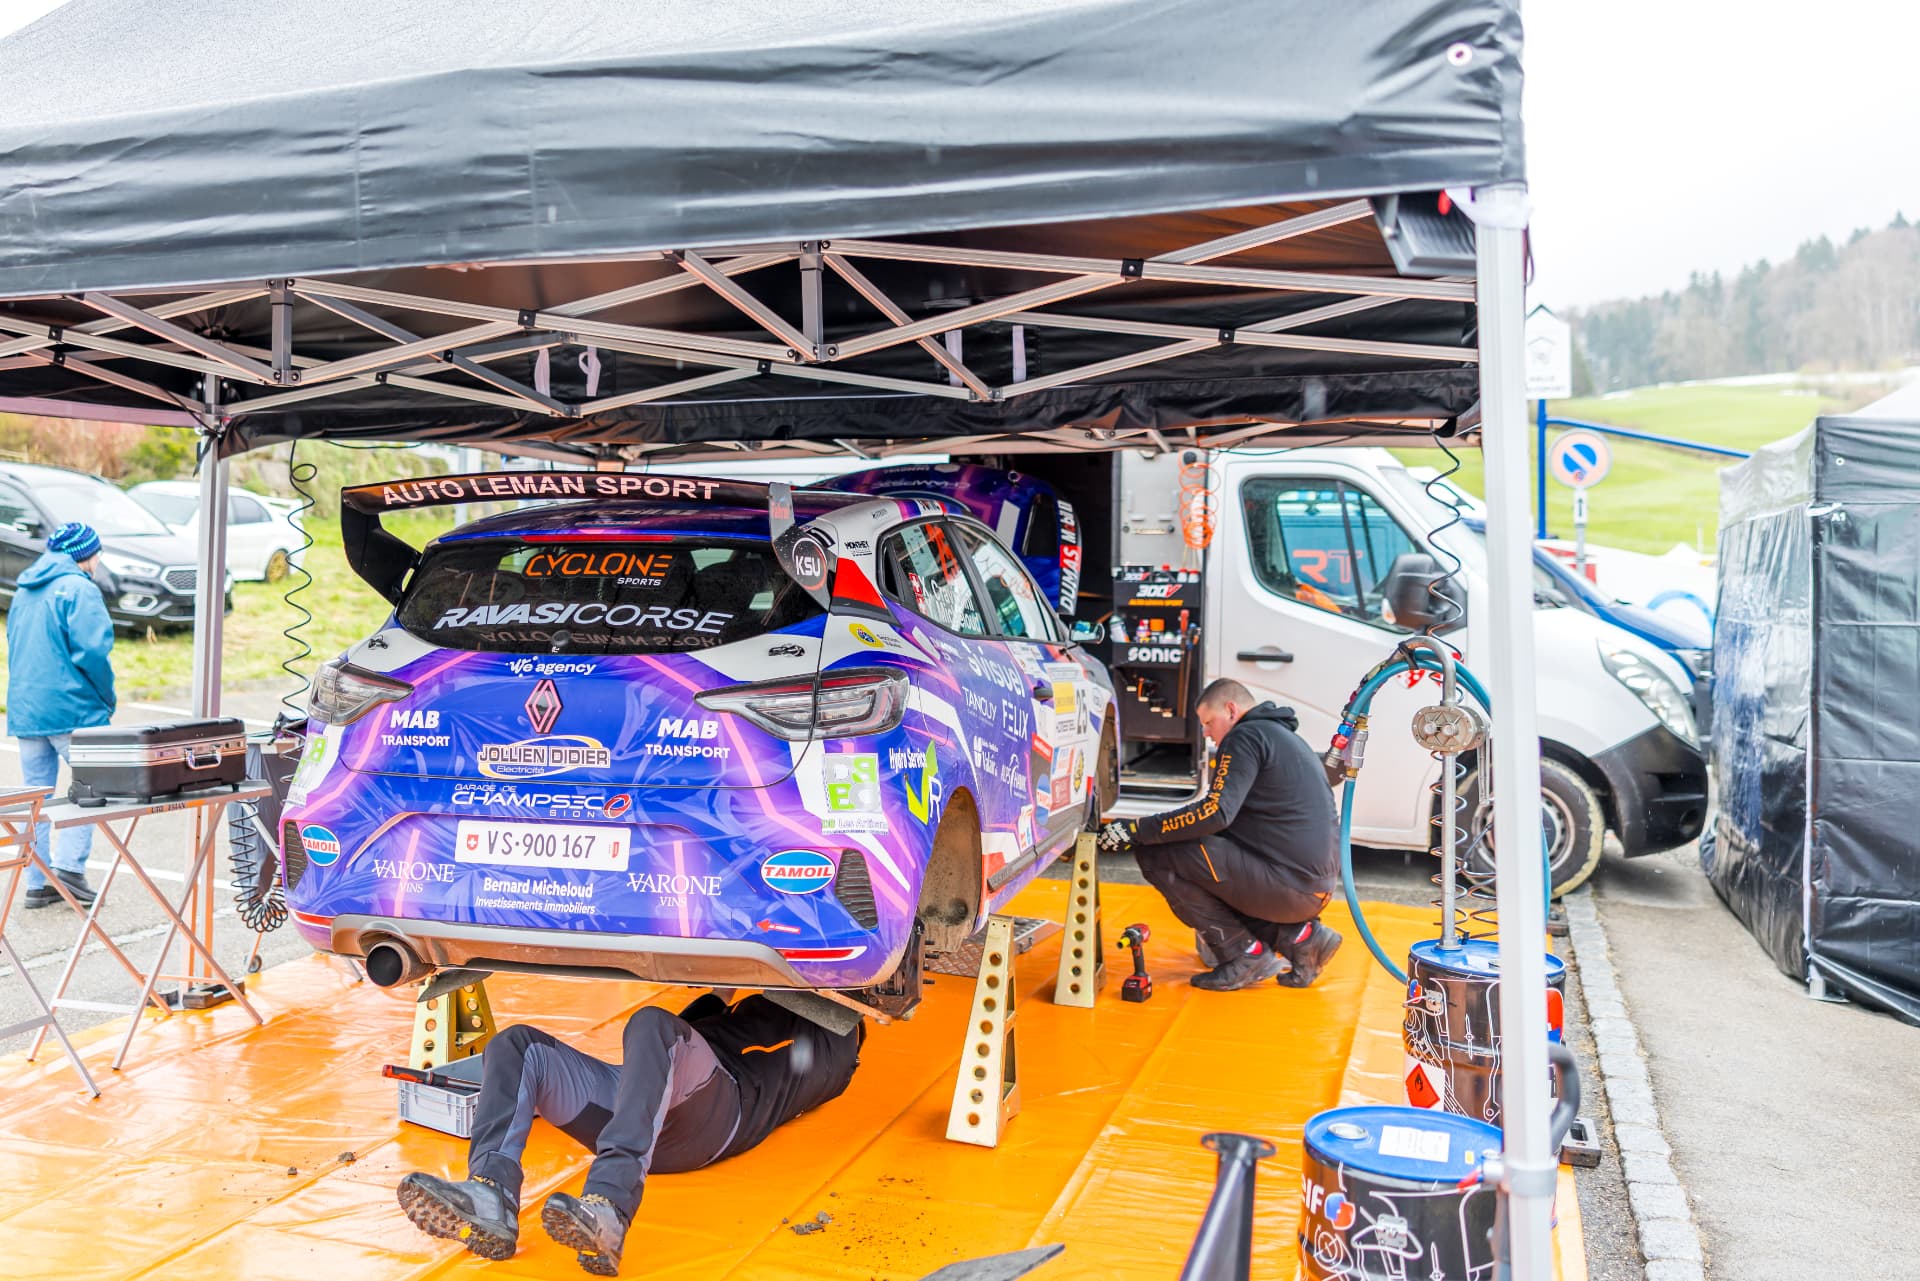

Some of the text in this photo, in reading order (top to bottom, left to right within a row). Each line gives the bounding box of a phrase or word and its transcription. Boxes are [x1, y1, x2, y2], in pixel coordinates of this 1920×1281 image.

[382, 475, 720, 505] AUTO LEMAN SPORT
[525, 552, 673, 578] CYCLONE
[794, 555, 821, 577] KSU
[1292, 549, 1363, 583] RT
[616, 577, 662, 587] SPORTS
[1060, 546, 1080, 613] DUMAS
[1136, 583, 1183, 598] 300V
[535, 661, 597, 676] agency
[390, 709, 441, 729] MAB
[657, 718, 719, 739] MAB
[1002, 698, 1029, 741] FELIX
[381, 734, 451, 747] TRANSPORT
[645, 743, 731, 759] TRANSPORT
[478, 746, 610, 767] JOLLIEN DIDIER
[888, 747, 908, 774] Hydro
[454, 783, 517, 793] GARAGE DE
[451, 791, 606, 809] CHAMPSEC
[549, 809, 596, 818] SION
[1161, 811, 1196, 834] AUTO
[303, 838, 339, 853] TAMOIL
[562, 834, 597, 859] 167
[371, 859, 458, 884] VARONE
[764, 866, 832, 878] TAMOIL
[398, 882, 424, 894] VINS
[483, 876, 594, 899] Bernard Micheloud
[626, 872, 723, 897] VARONE
[474, 894, 597, 915] Investissements immobiliers
[659, 895, 689, 908] VINS
